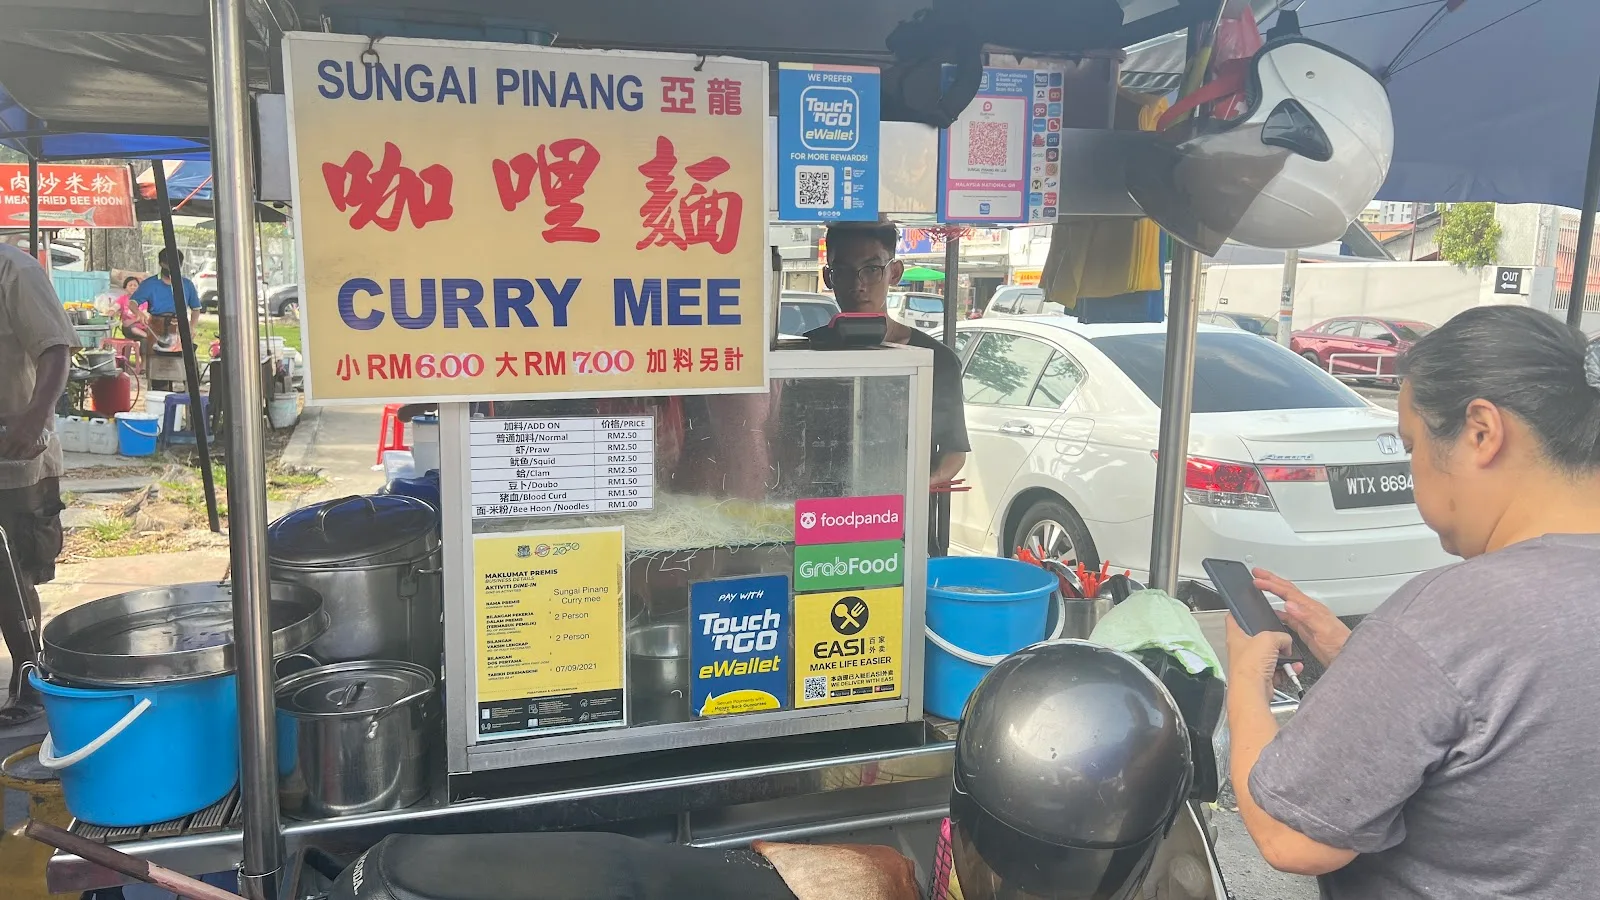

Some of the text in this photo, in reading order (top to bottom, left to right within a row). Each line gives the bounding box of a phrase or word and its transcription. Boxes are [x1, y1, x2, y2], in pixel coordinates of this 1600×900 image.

[808, 74, 852, 82] WE PREFER
[318, 60, 643, 111] SUNGAI PINANG
[661, 76, 742, 116] 亞龍
[806, 98, 853, 112] Touch
[806, 129, 854, 140] eWallet
[791, 152, 868, 162] FOR MORE REWARDS!
[0, 171, 117, 194] 肉炒米粉
[38, 196, 67, 205] FRIED
[70, 196, 90, 205] BEE
[94, 196, 122, 205] HOON
[322, 136, 742, 255] 咖哩麵
[1502, 272, 1519, 282] OUT
[337, 278, 741, 331] CURRY MEE
[336, 347, 743, 381] 小 RM6.00 大 RM7.00 加料另計
[504, 422, 545, 431] 加料/ADD
[602, 420, 645, 429] 价格/PRICE
[496, 433, 568, 443] 普通加料/Normal
[608, 432, 637, 440] RM2.50
[516, 446, 550, 454] 虾/Praw
[510, 457, 556, 467] 鱿鱼/Squid
[608, 455, 637, 463] RM2.50
[516, 470, 550, 478] 蛤/Clam
[1347, 475, 1414, 495] WTX 8694
[500, 492, 567, 502] 猪血/Blood Curd
[821, 510, 899, 528] foodpanda
[800, 553, 898, 578] GrabFood
[554, 586, 609, 596] Sungai Pinang
[562, 597, 582, 606] Curry
[718, 590, 764, 604] PAY WITH
[562, 611, 588, 620] Person
[699, 608, 781, 636] Touch
[870, 636, 885, 644] 百家
[814, 638, 865, 659] EASI
[556, 663, 597, 673] 07/09/2021
[699, 655, 781, 679] eWallet
[810, 656, 892, 672] MAKE LIFE EASIER
